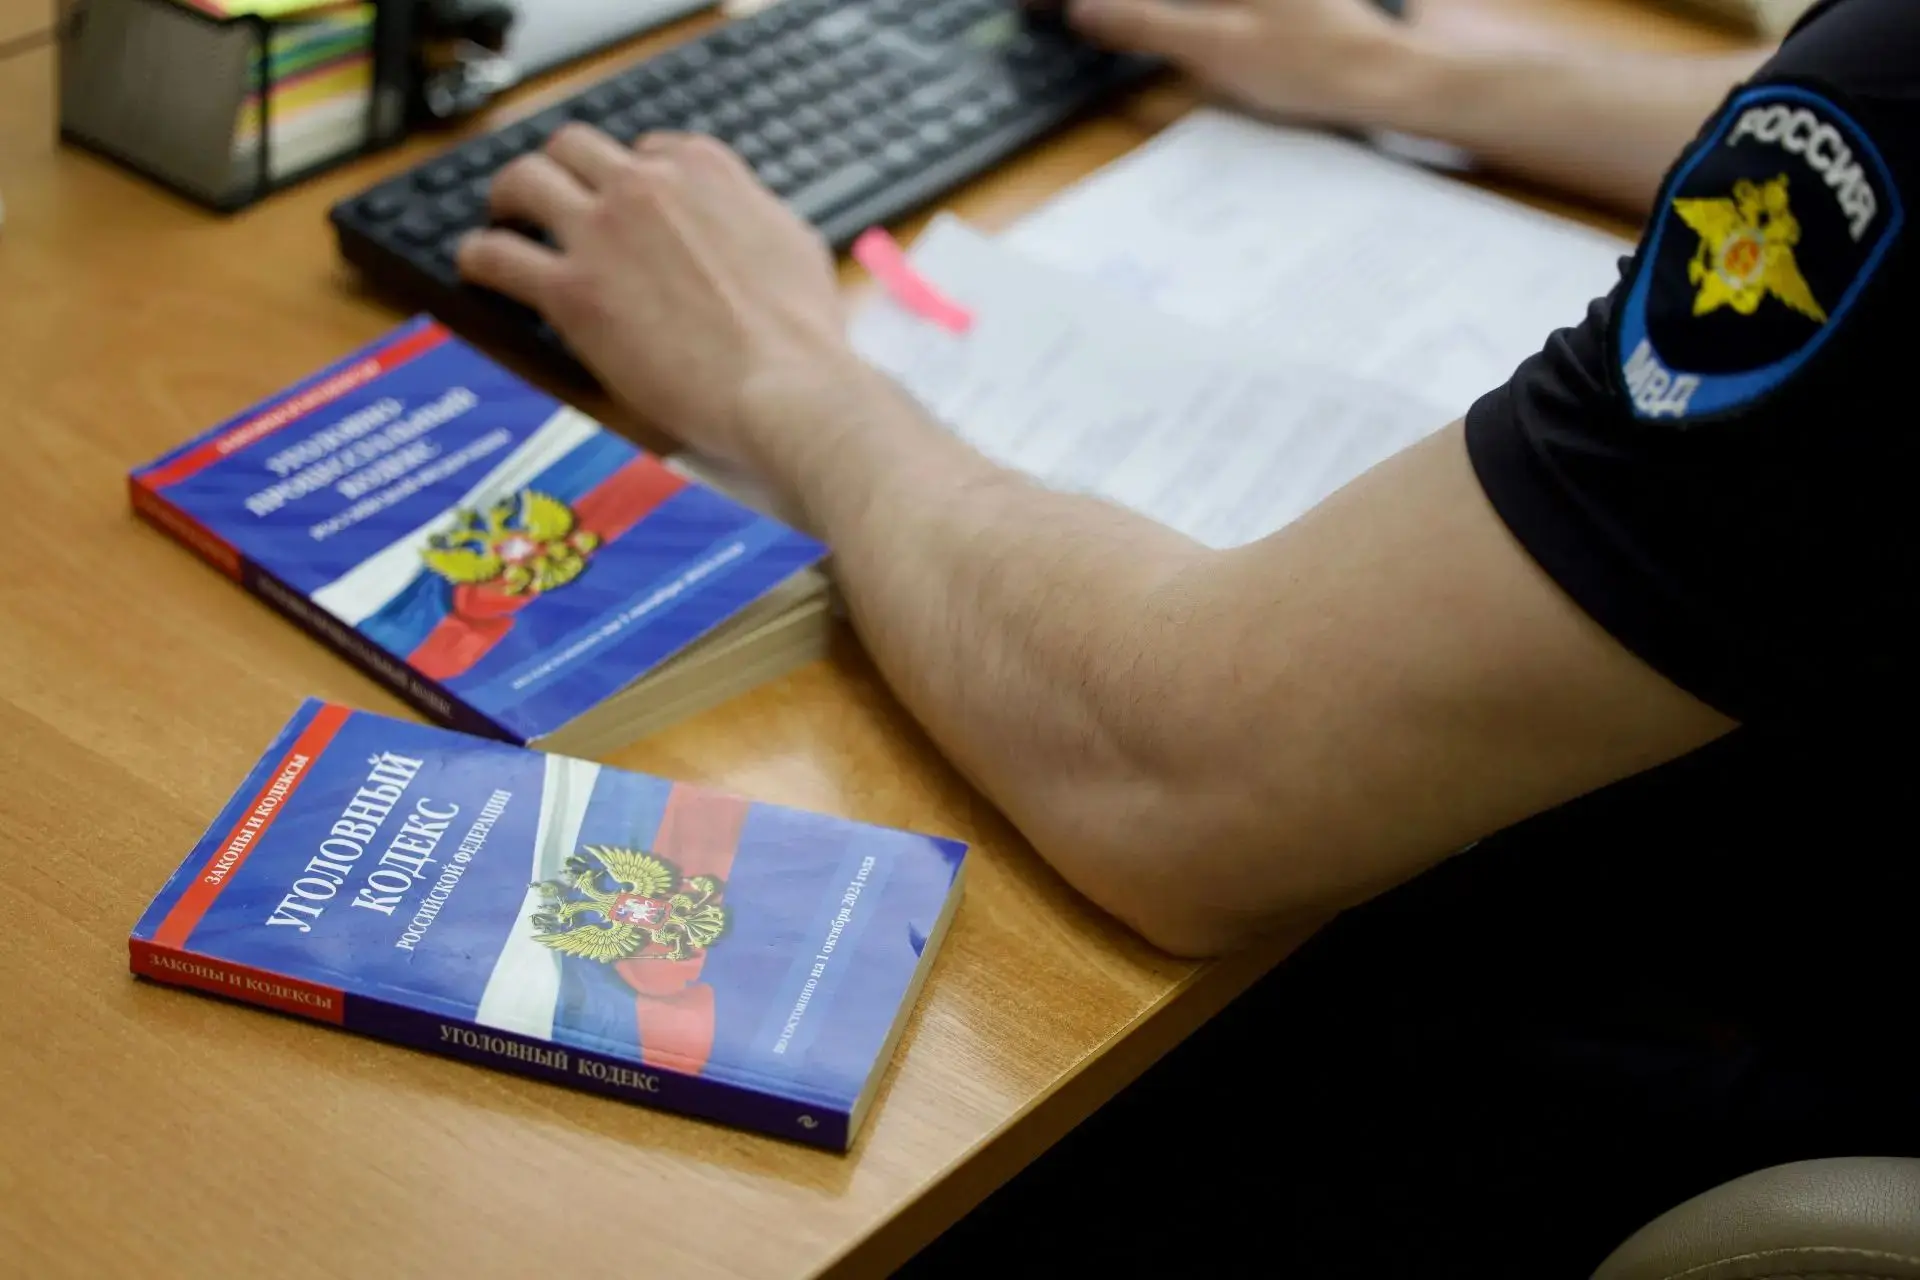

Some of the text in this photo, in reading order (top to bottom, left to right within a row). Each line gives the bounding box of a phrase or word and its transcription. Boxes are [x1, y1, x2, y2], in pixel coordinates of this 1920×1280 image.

[1726, 105, 1877, 243] РОССИЯ
[1622, 338, 1700, 418] МВД
[204, 753, 310, 885] ЗАКОНЫ И КОДЕКСЫ
[266, 750, 424, 933] УГОЛОВНЫЙ
[352, 797, 460, 916] КОДЕКС
[395, 789, 513, 951] РОССИЙСКОЙ ФЕДЕРАЦИИ
[149, 953, 333, 1010] ЗАКОНЫ И КОДЕКСЫ
[810, 963, 826, 978] на
[822, 908, 851, 953] октября
[841, 881, 865, 907] 2024
[439, 1023, 660, 1093] УГОЛОВНЫЙ КОДЕКС
